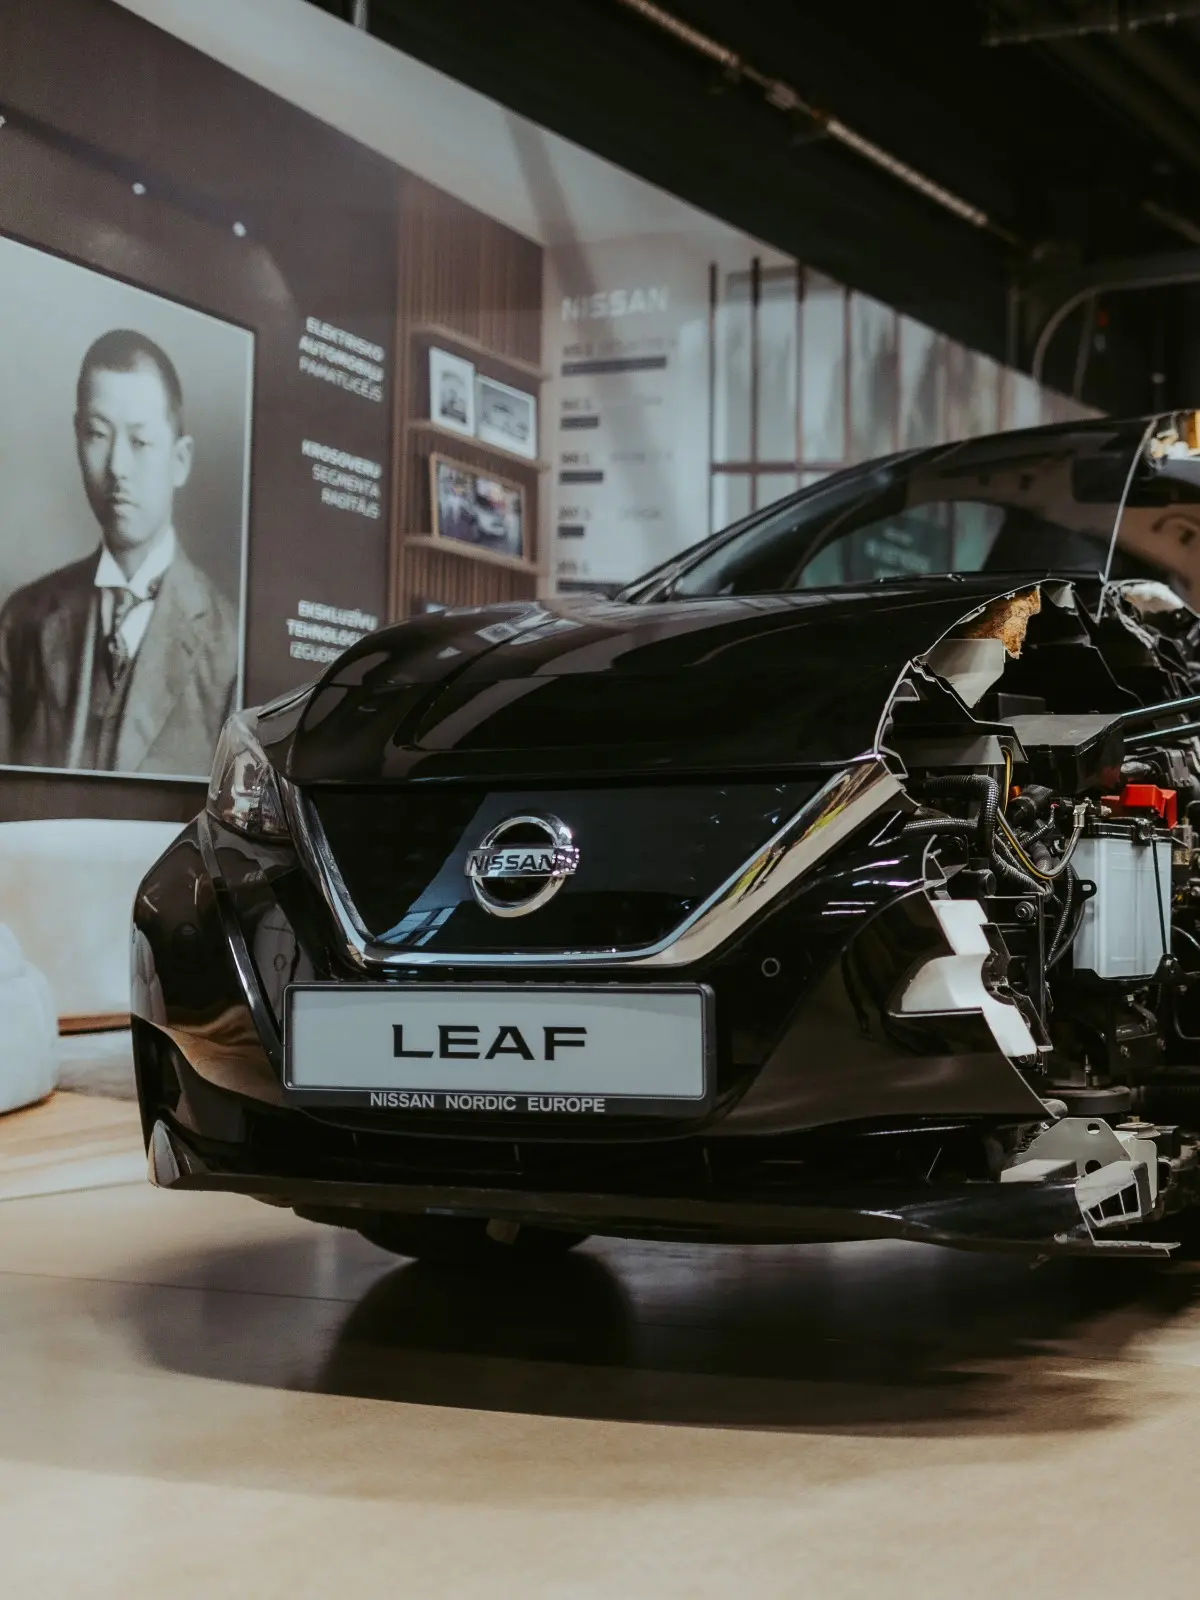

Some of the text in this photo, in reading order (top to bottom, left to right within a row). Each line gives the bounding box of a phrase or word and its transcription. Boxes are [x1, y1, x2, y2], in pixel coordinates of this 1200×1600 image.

[561, 284, 669, 322] NISSAN
[469, 854, 557, 873] NISSAN
[392, 1024, 588, 1061] LEAF
[370, 1091, 606, 1113] NISSAN NORDIC EUROPE
